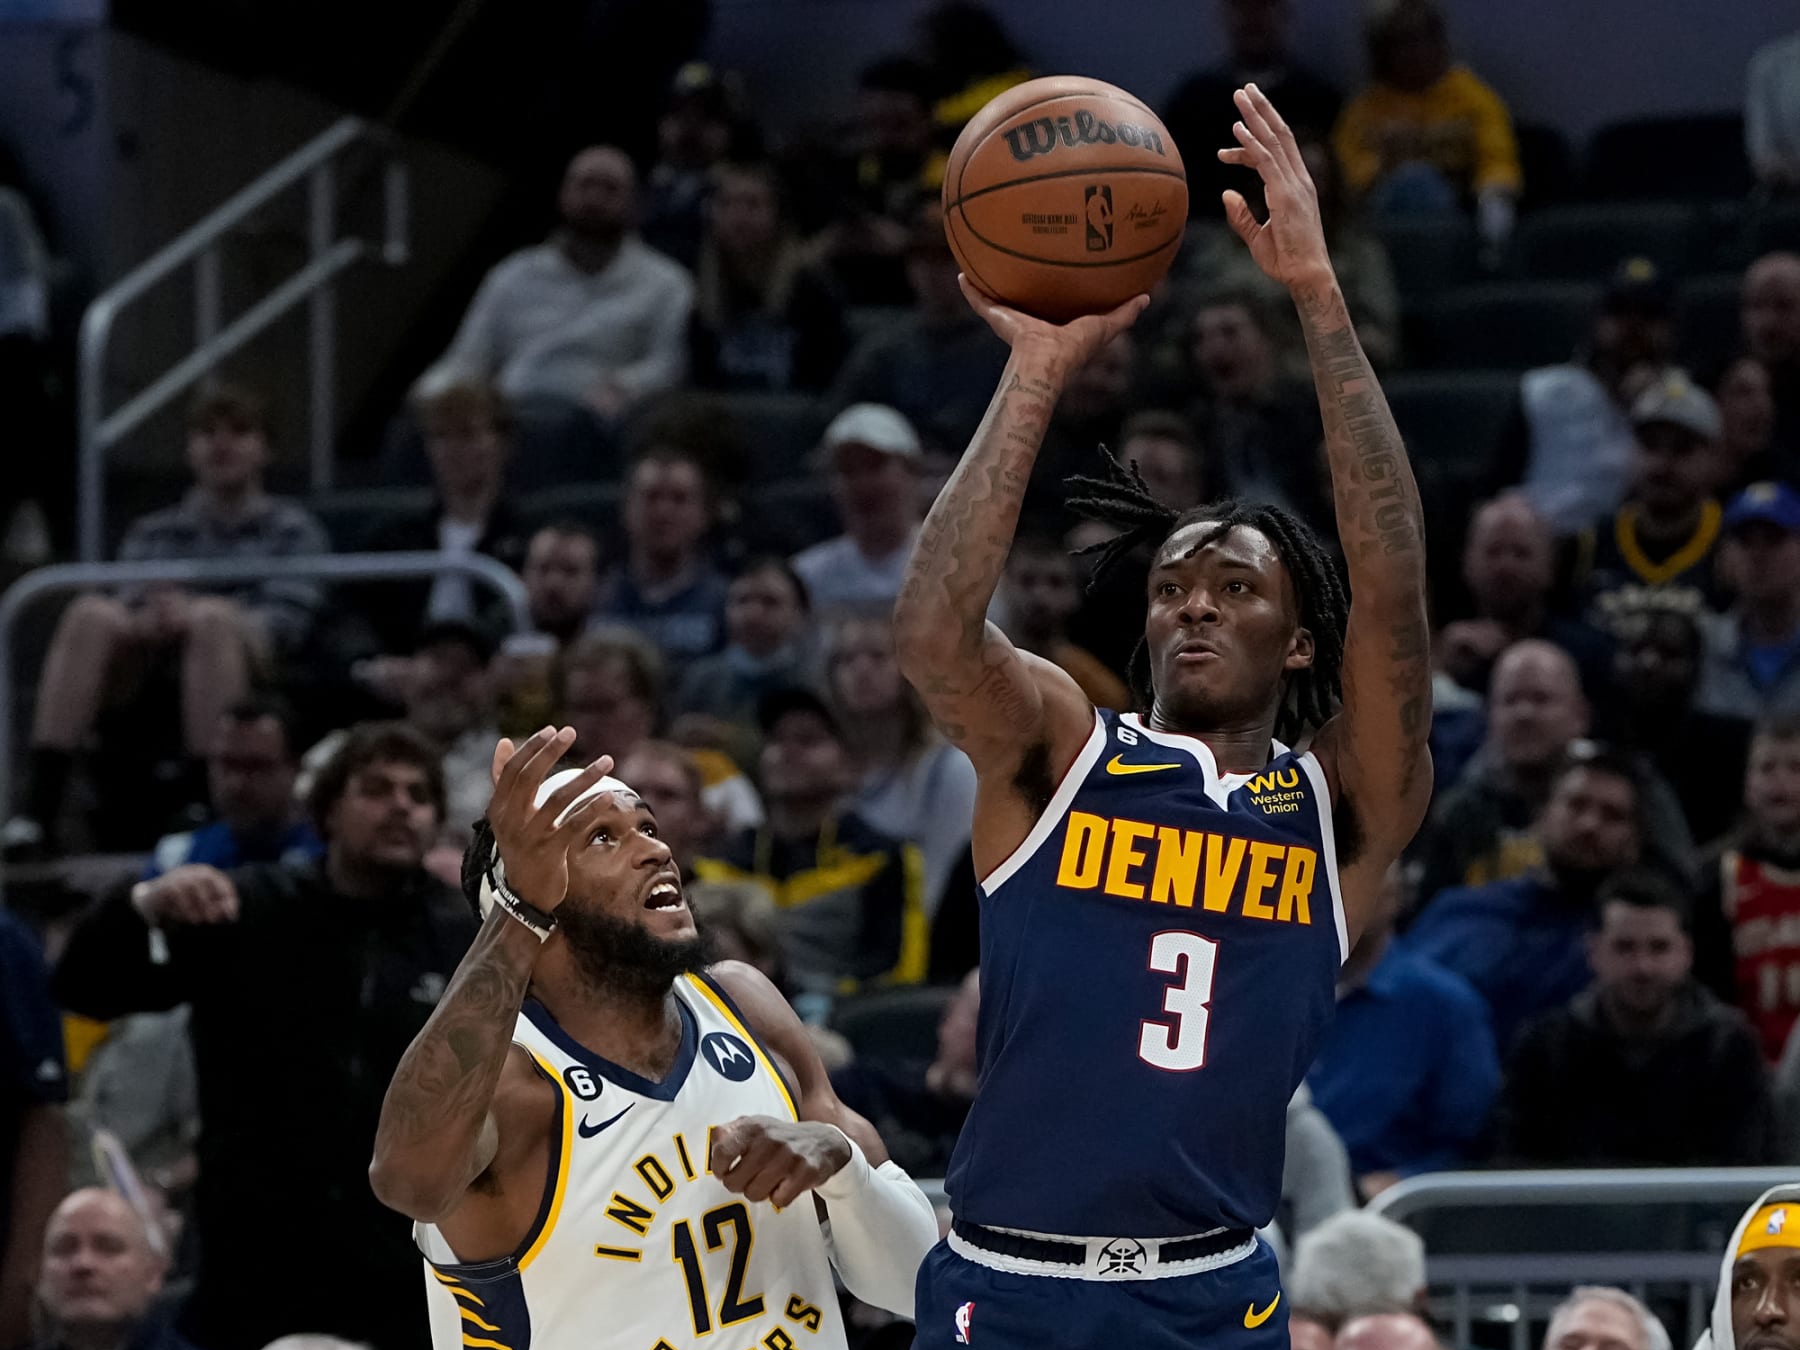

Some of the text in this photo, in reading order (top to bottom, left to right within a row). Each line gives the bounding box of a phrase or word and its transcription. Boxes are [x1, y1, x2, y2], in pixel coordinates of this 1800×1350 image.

[1004, 109, 1167, 162] Wilson
[1318, 325, 1418, 557] WILMINGTON
[1116, 726, 1139, 747] 6
[1245, 768, 1300, 794] WU
[1250, 788, 1304, 807] Western
[1262, 800, 1299, 815] Union
[1056, 810, 1319, 926] DENVER
[1136, 929, 1221, 1073] 3
[570, 1069, 598, 1097] 6
[671, 1201, 767, 1339] 12
